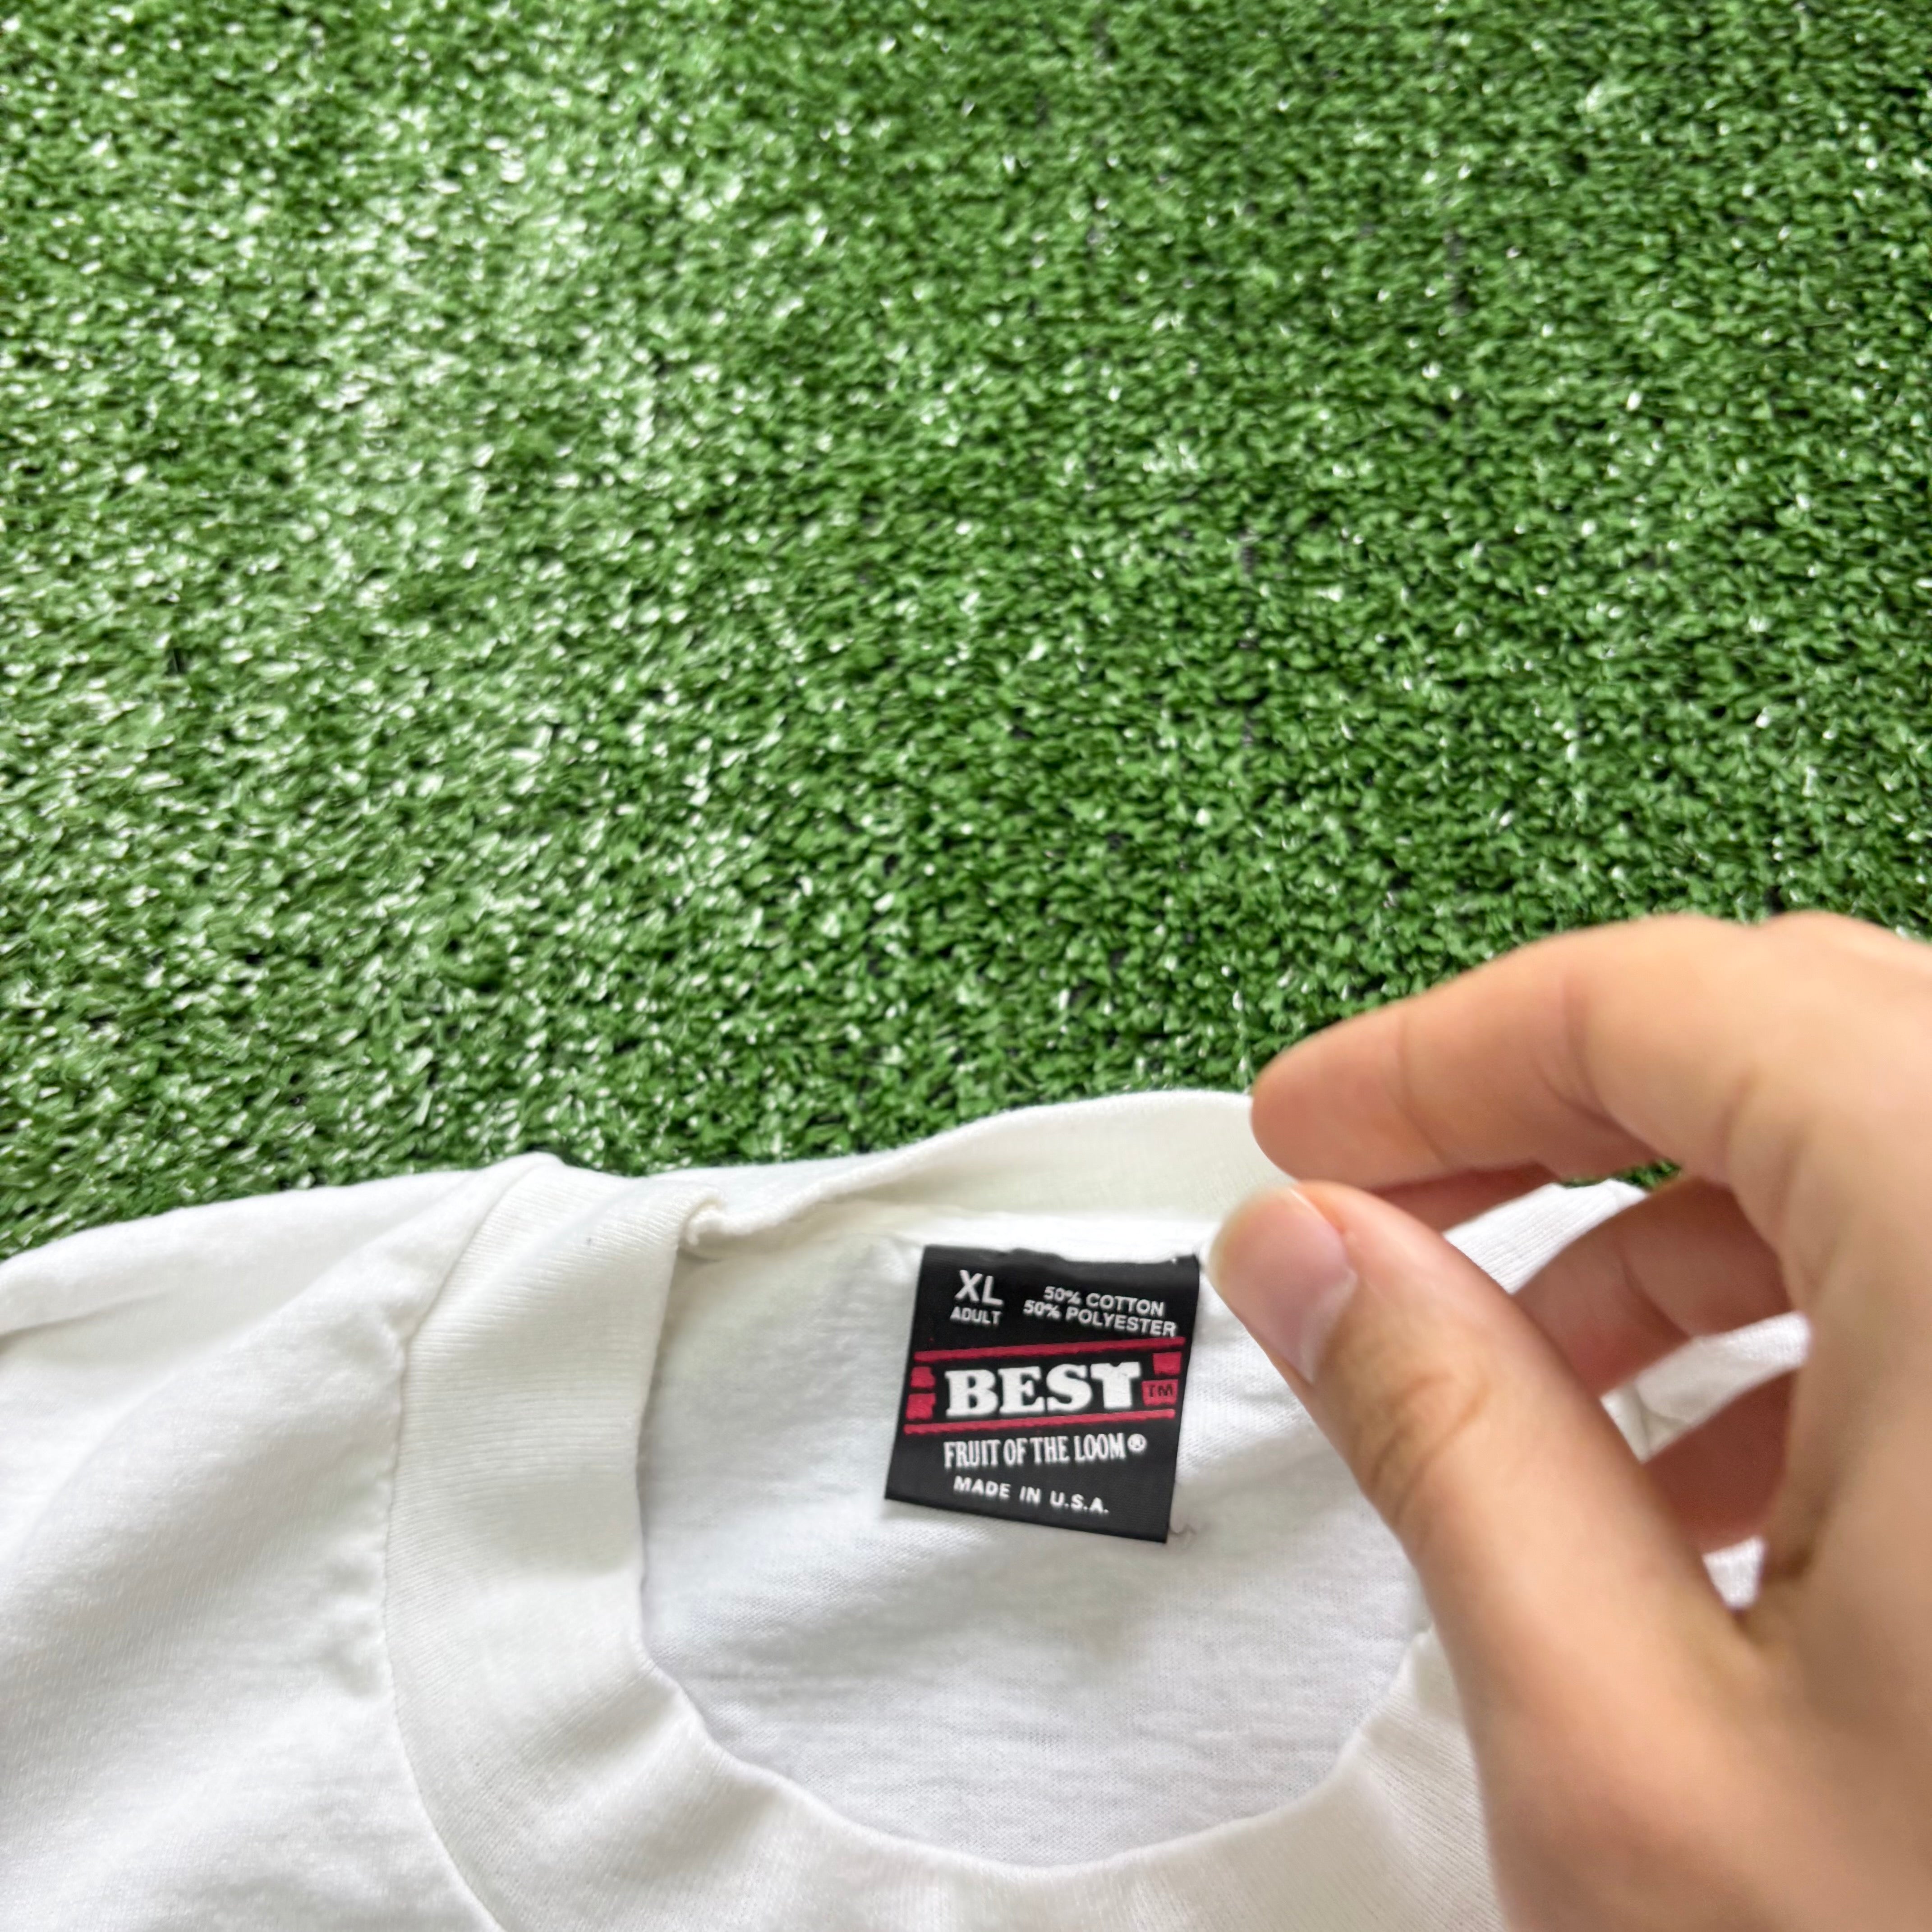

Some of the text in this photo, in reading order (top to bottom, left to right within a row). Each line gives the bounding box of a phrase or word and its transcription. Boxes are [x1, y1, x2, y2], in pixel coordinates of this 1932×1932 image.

[954, 1270, 1003, 1306] XL
[1044, 1286, 1165, 1317] 50% COTTON
[950, 1306, 1001, 1326] ADULT
[1023, 1301, 1177, 1337] 50% POLYESTER
[944, 1362, 1141, 1418] BEST
[944, 1440, 998, 1468] FRUIT
[1003, 1440, 1025, 1465] OF
[1033, 1436, 1069, 1463] THE
[954, 1476, 1109, 1514] MADE IN U.S.A.
